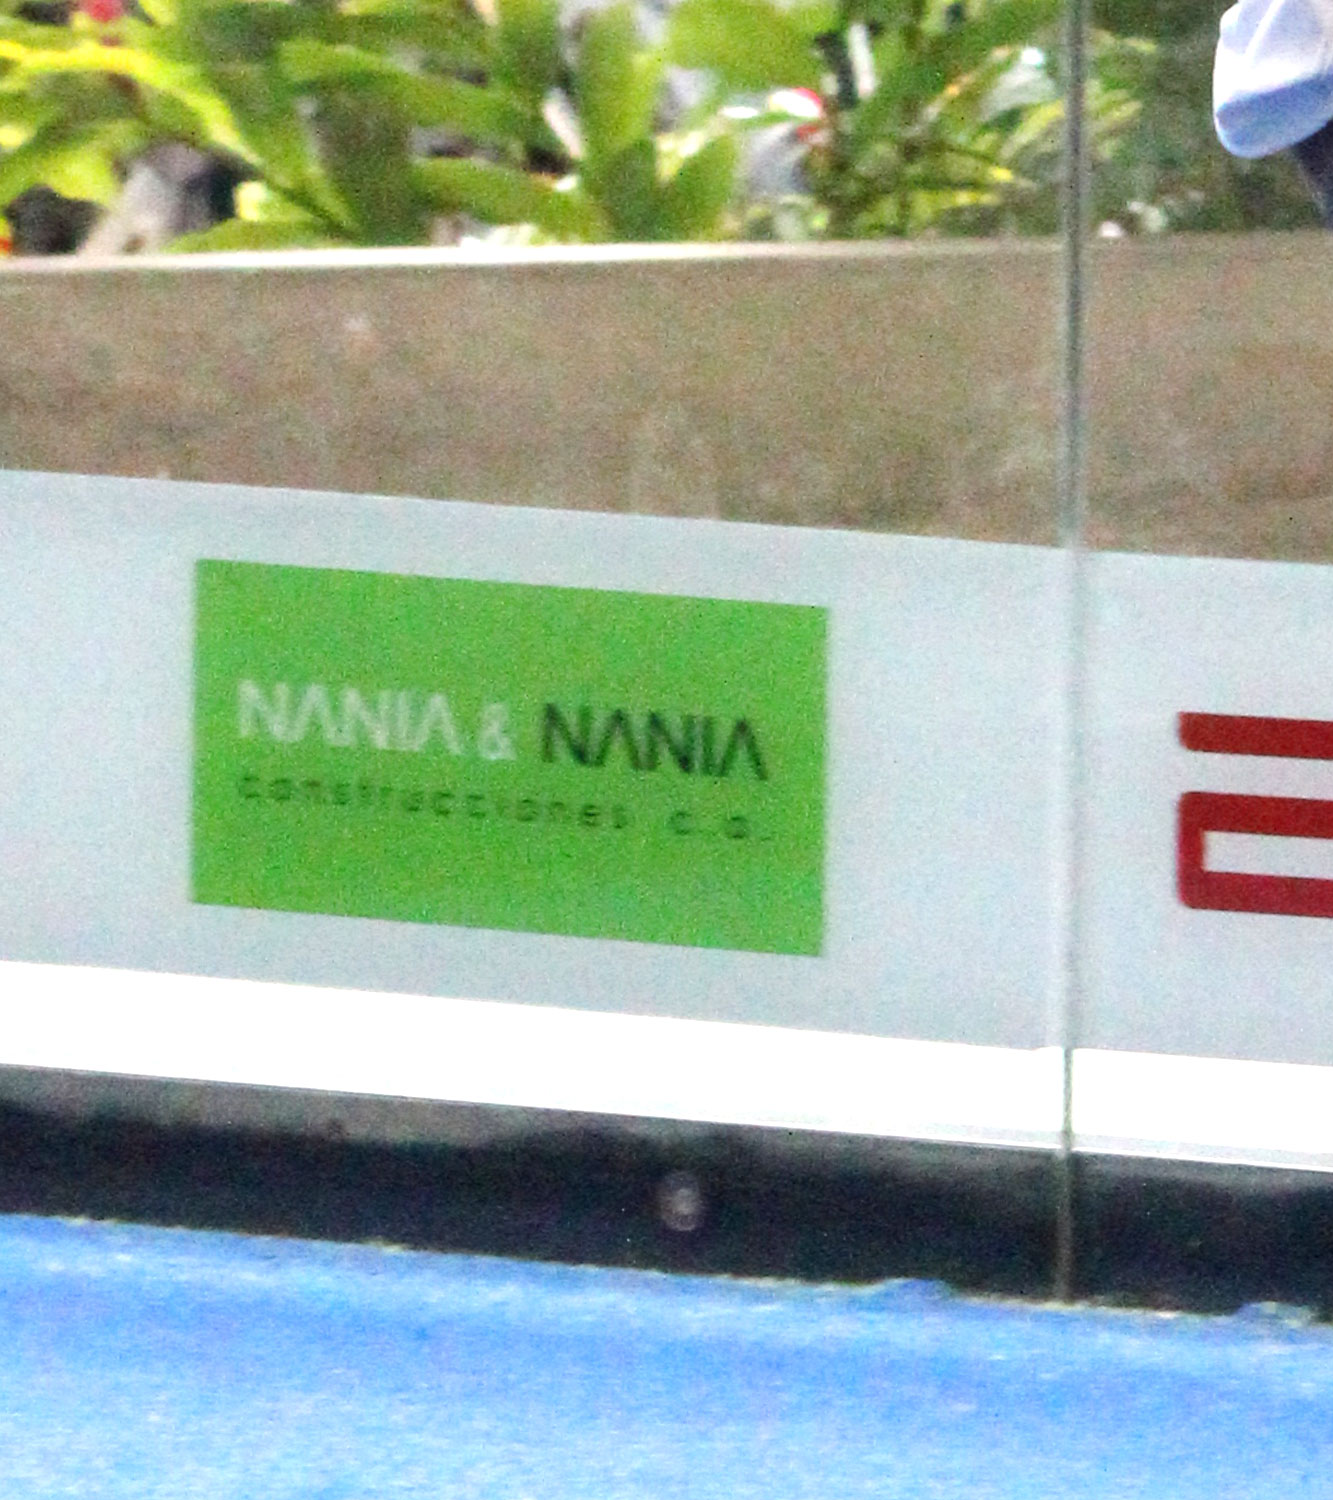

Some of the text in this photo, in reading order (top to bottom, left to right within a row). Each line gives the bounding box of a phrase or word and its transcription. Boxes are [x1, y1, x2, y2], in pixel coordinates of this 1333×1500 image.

[236, 680, 770, 780] NANIA & NANIA
